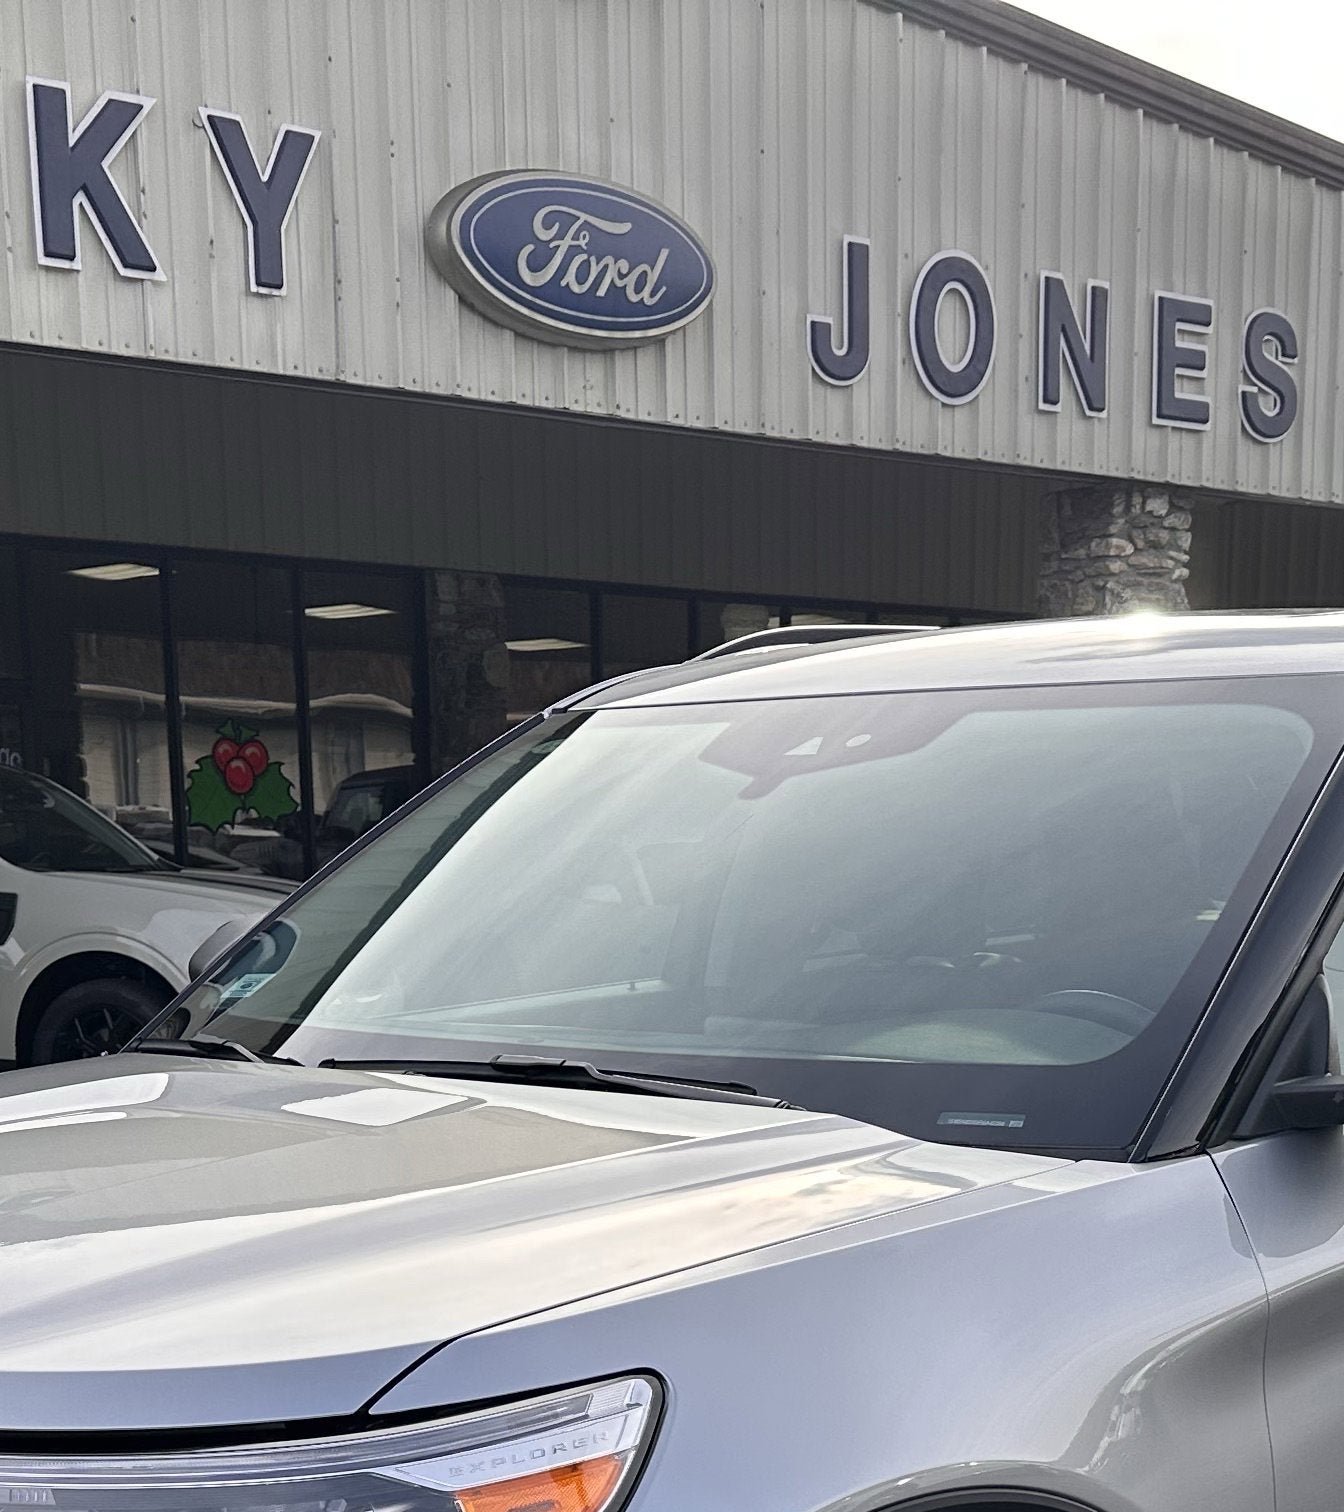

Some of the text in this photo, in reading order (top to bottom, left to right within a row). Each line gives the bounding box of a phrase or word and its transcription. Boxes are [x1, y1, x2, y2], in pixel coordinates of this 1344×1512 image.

[517, 204, 668, 307] Ford
[806, 234, 1299, 444] JONES
[448, 1431, 609, 1478] EXPLORER
